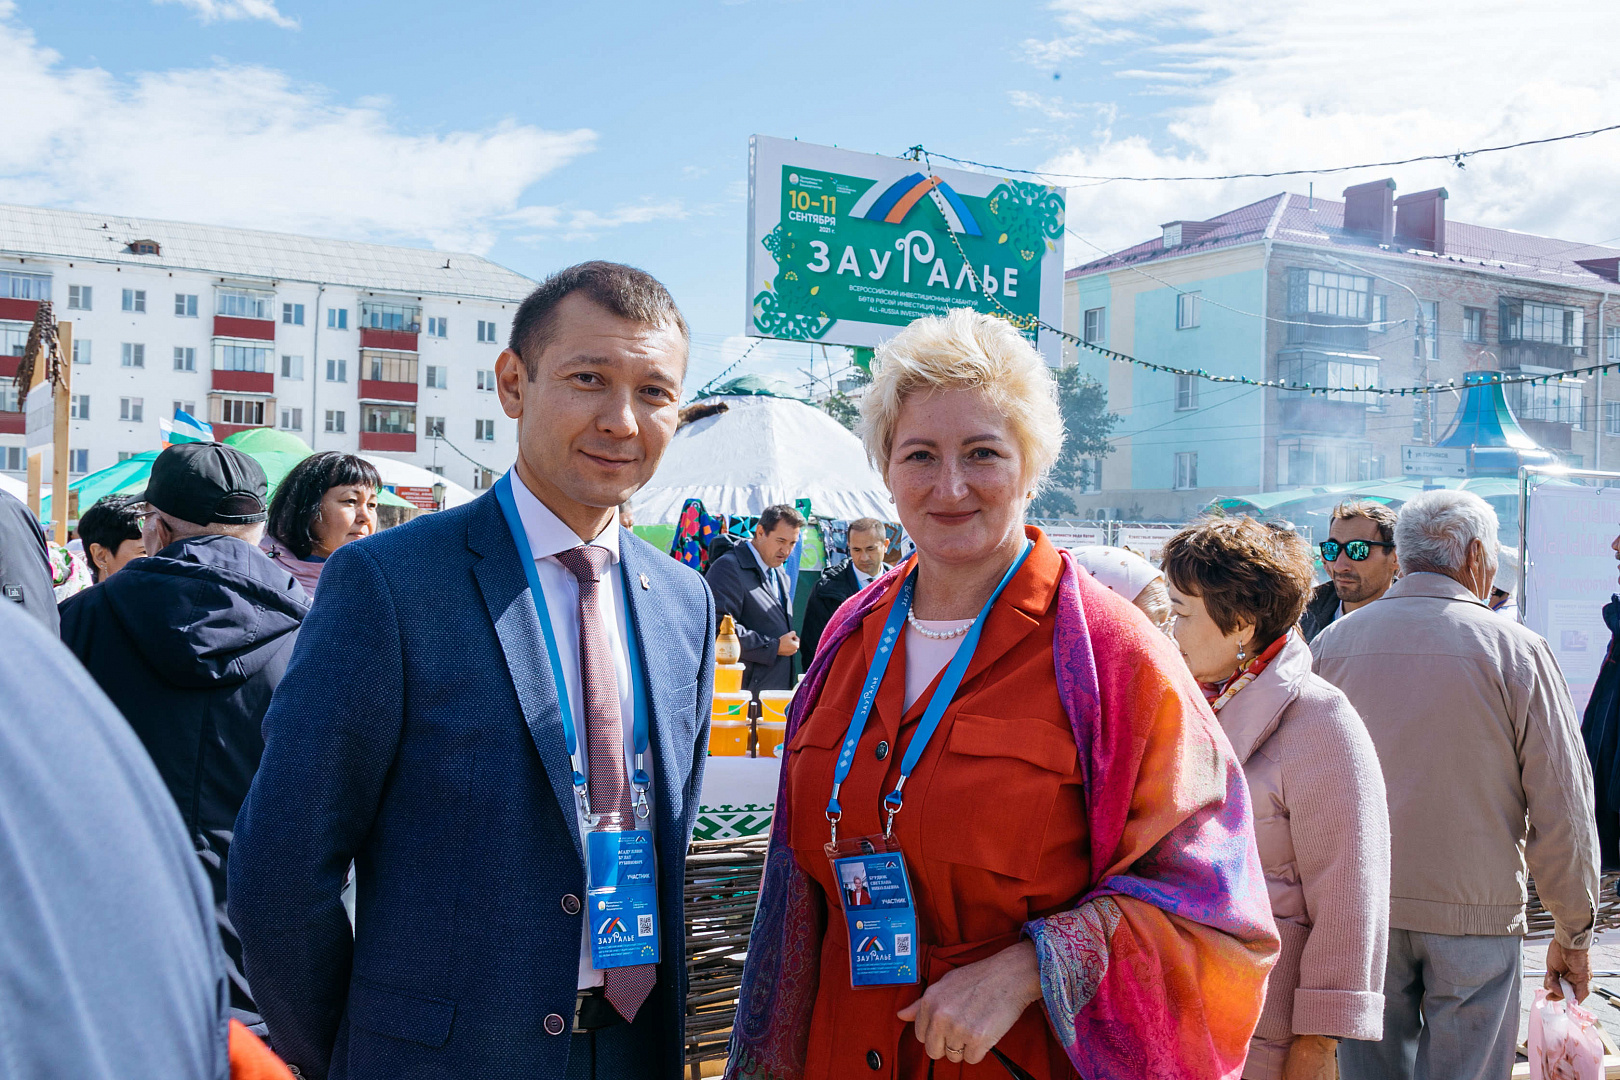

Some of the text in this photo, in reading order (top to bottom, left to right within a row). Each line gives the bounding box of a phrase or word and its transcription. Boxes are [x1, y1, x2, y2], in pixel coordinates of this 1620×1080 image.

[788, 210, 836, 226] СЕНТЯБРЯ
[806, 229, 1019, 298] ЗАУРАЛЬЕ
[848, 285, 979, 306] ВСЕРОССИЙСКИЙ ИНВЕСТИЦИОННЫЙ САБАНТУЙ
[868, 306, 899, 315] ALL-RUSSIA
[897, 300, 936, 311] ИНВЕСТИЦИЯ
[861, 676, 879, 715] ЗАУРАЛЬЕ
[597, 931, 635, 945] ЗАУРАЛЬЕ
[856, 949, 892, 963] ЗАУРАЛЬЕ
